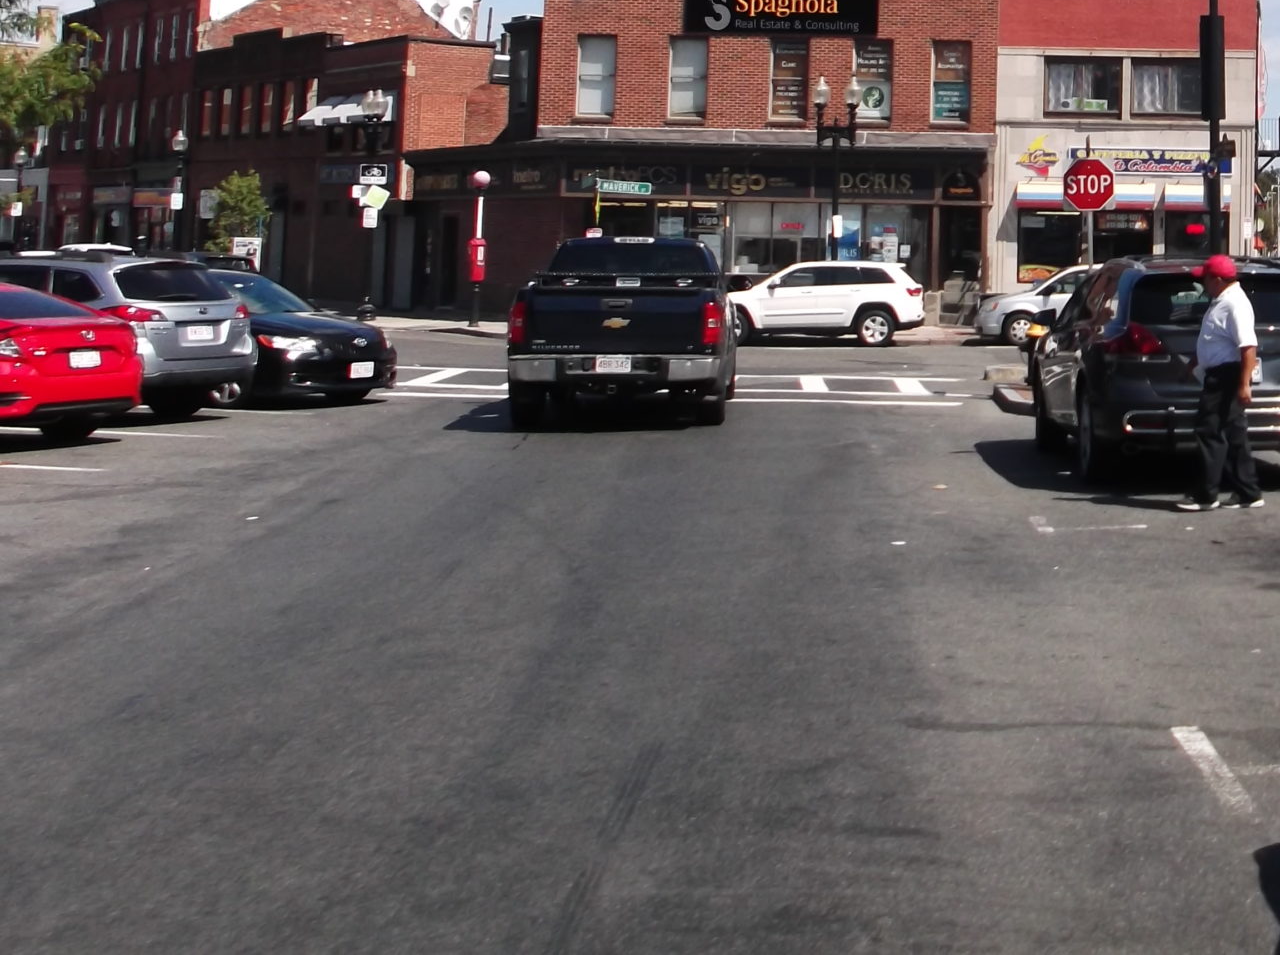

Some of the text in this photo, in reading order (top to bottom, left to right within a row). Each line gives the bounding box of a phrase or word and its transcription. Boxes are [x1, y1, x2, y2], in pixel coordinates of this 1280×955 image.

[735, 19, 860, 33] Real Estate & Consulting
[602, 181, 640, 192] MAVERICK
[705, 167, 767, 196] vigo
[1066, 174, 1112, 195] STOP
